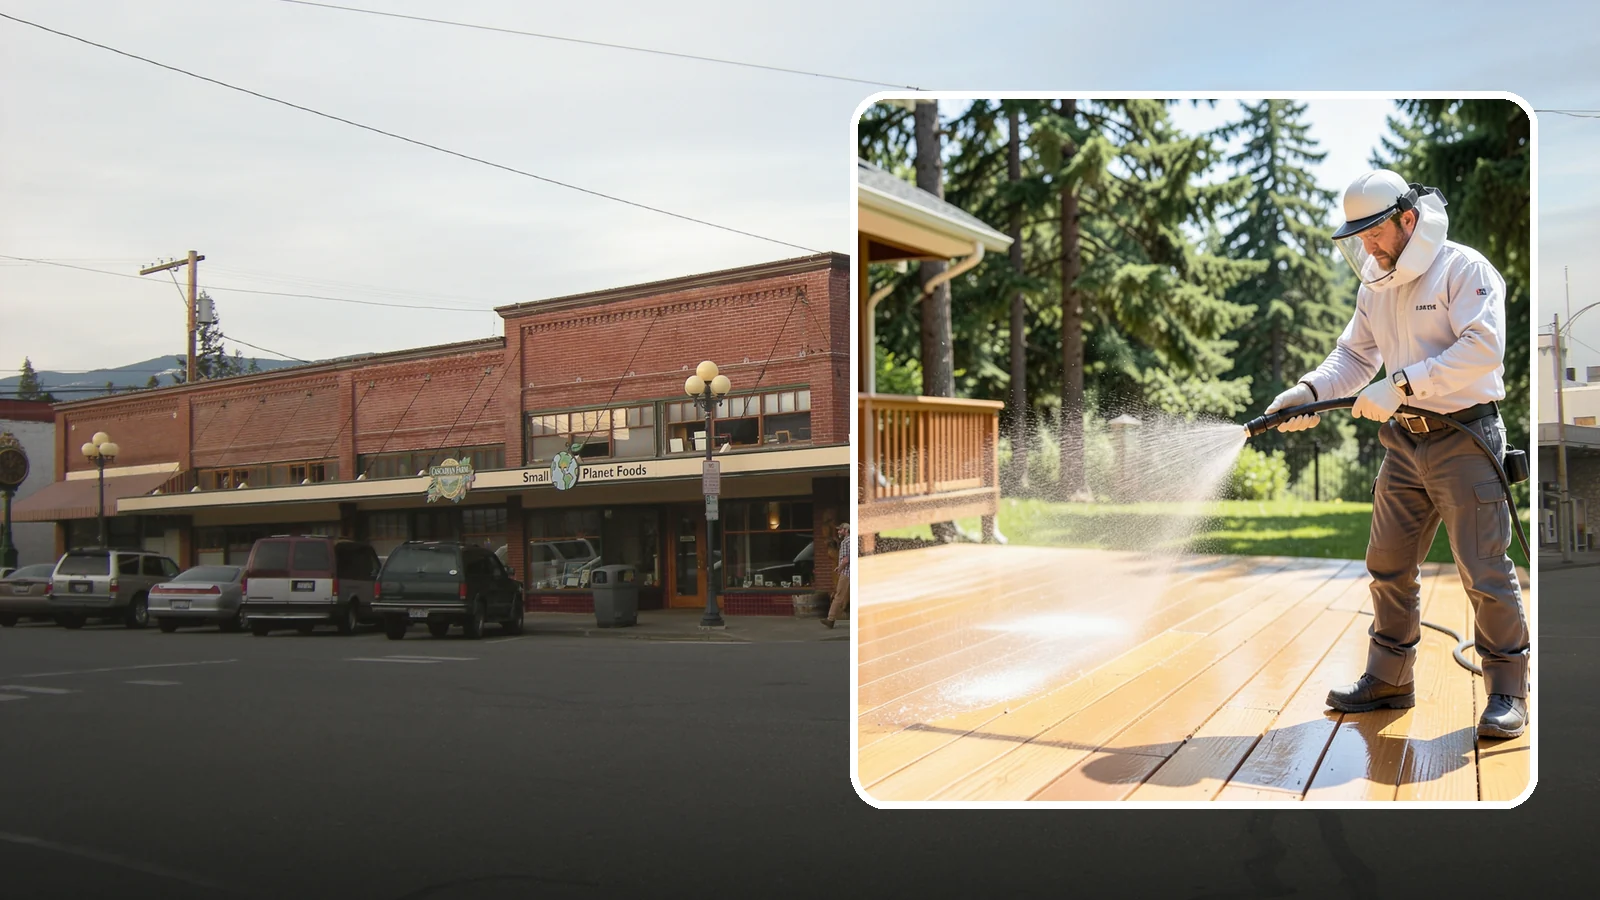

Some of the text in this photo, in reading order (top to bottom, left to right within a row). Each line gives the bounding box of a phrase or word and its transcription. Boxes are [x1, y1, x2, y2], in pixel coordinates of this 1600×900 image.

[523, 464, 646, 482] Small Planet Foods
